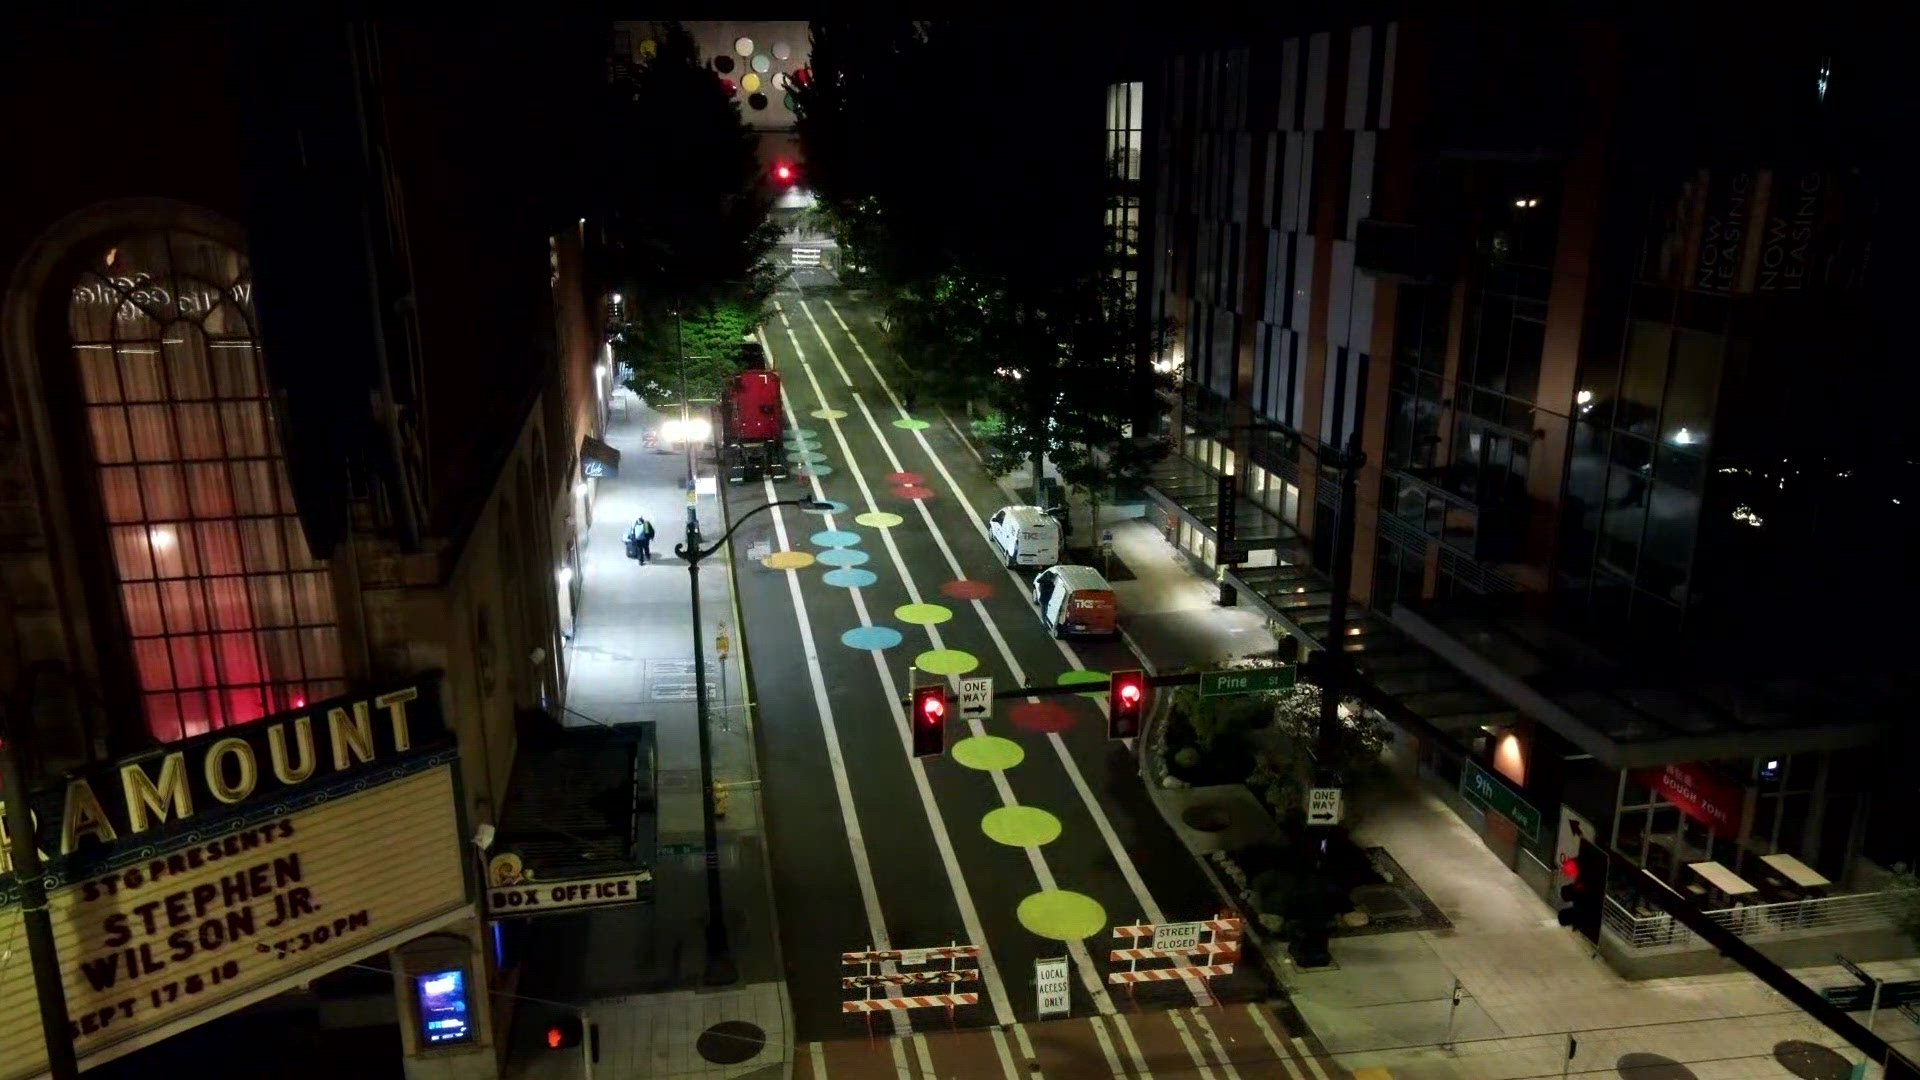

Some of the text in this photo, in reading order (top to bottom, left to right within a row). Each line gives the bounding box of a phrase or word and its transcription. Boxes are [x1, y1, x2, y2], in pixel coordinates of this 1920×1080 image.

[1717, 169, 1751, 290] LEASING
[1784, 170, 1821, 290] LEASING
[1699, 216, 1722, 288] NOW
[1760, 217, 1789, 290] NOW
[964, 682, 987, 692] ONE
[1218, 676, 1279, 689] Pine St
[963, 693, 987, 702] WAY
[1314, 791, 1336, 800] ONE
[1476, 774, 1493, 799] 9th
[1663, 774, 1697, 802] DOUGH
[1312, 801, 1336, 810] WAY
[82, 819, 295, 901] STG PRESENTS
[104, 853, 301, 947] STEPHEN
[492, 880, 629, 908] BOX OFFICE
[82, 887, 321, 991] WILSON JR.
[1157, 939, 1195, 949] CLOSED
[1159, 926, 1196, 937] STREET
[1040, 970, 1064, 979] LOCAL
[69, 998, 137, 1039] SEPT
[151, 981, 179, 1008] 17
[211, 960, 239, 984] 18
[1040, 982, 1067, 993] ACCESS
[1044, 997, 1063, 1007] ONLY
